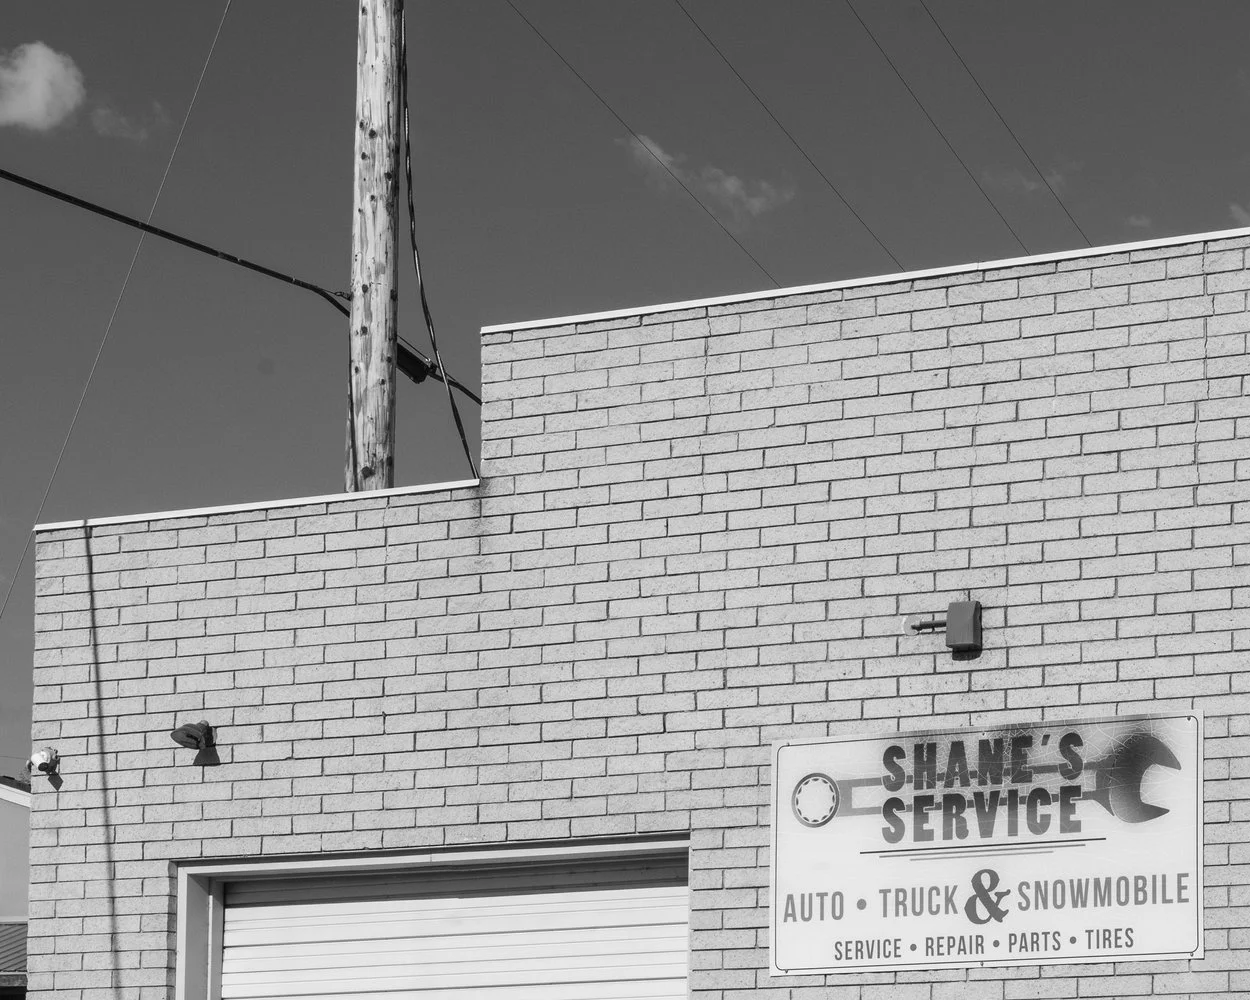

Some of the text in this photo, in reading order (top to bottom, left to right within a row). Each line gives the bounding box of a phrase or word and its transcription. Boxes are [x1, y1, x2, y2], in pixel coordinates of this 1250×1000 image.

[882, 732, 1084, 792] SHANE'S
[882, 785, 1082, 844] SERVICE
[783, 869, 1190, 925] AUTO TRUCK & SNOWMOBILE
[834, 927, 1135, 960] SERVICE REPAIR PARTS TIRES
